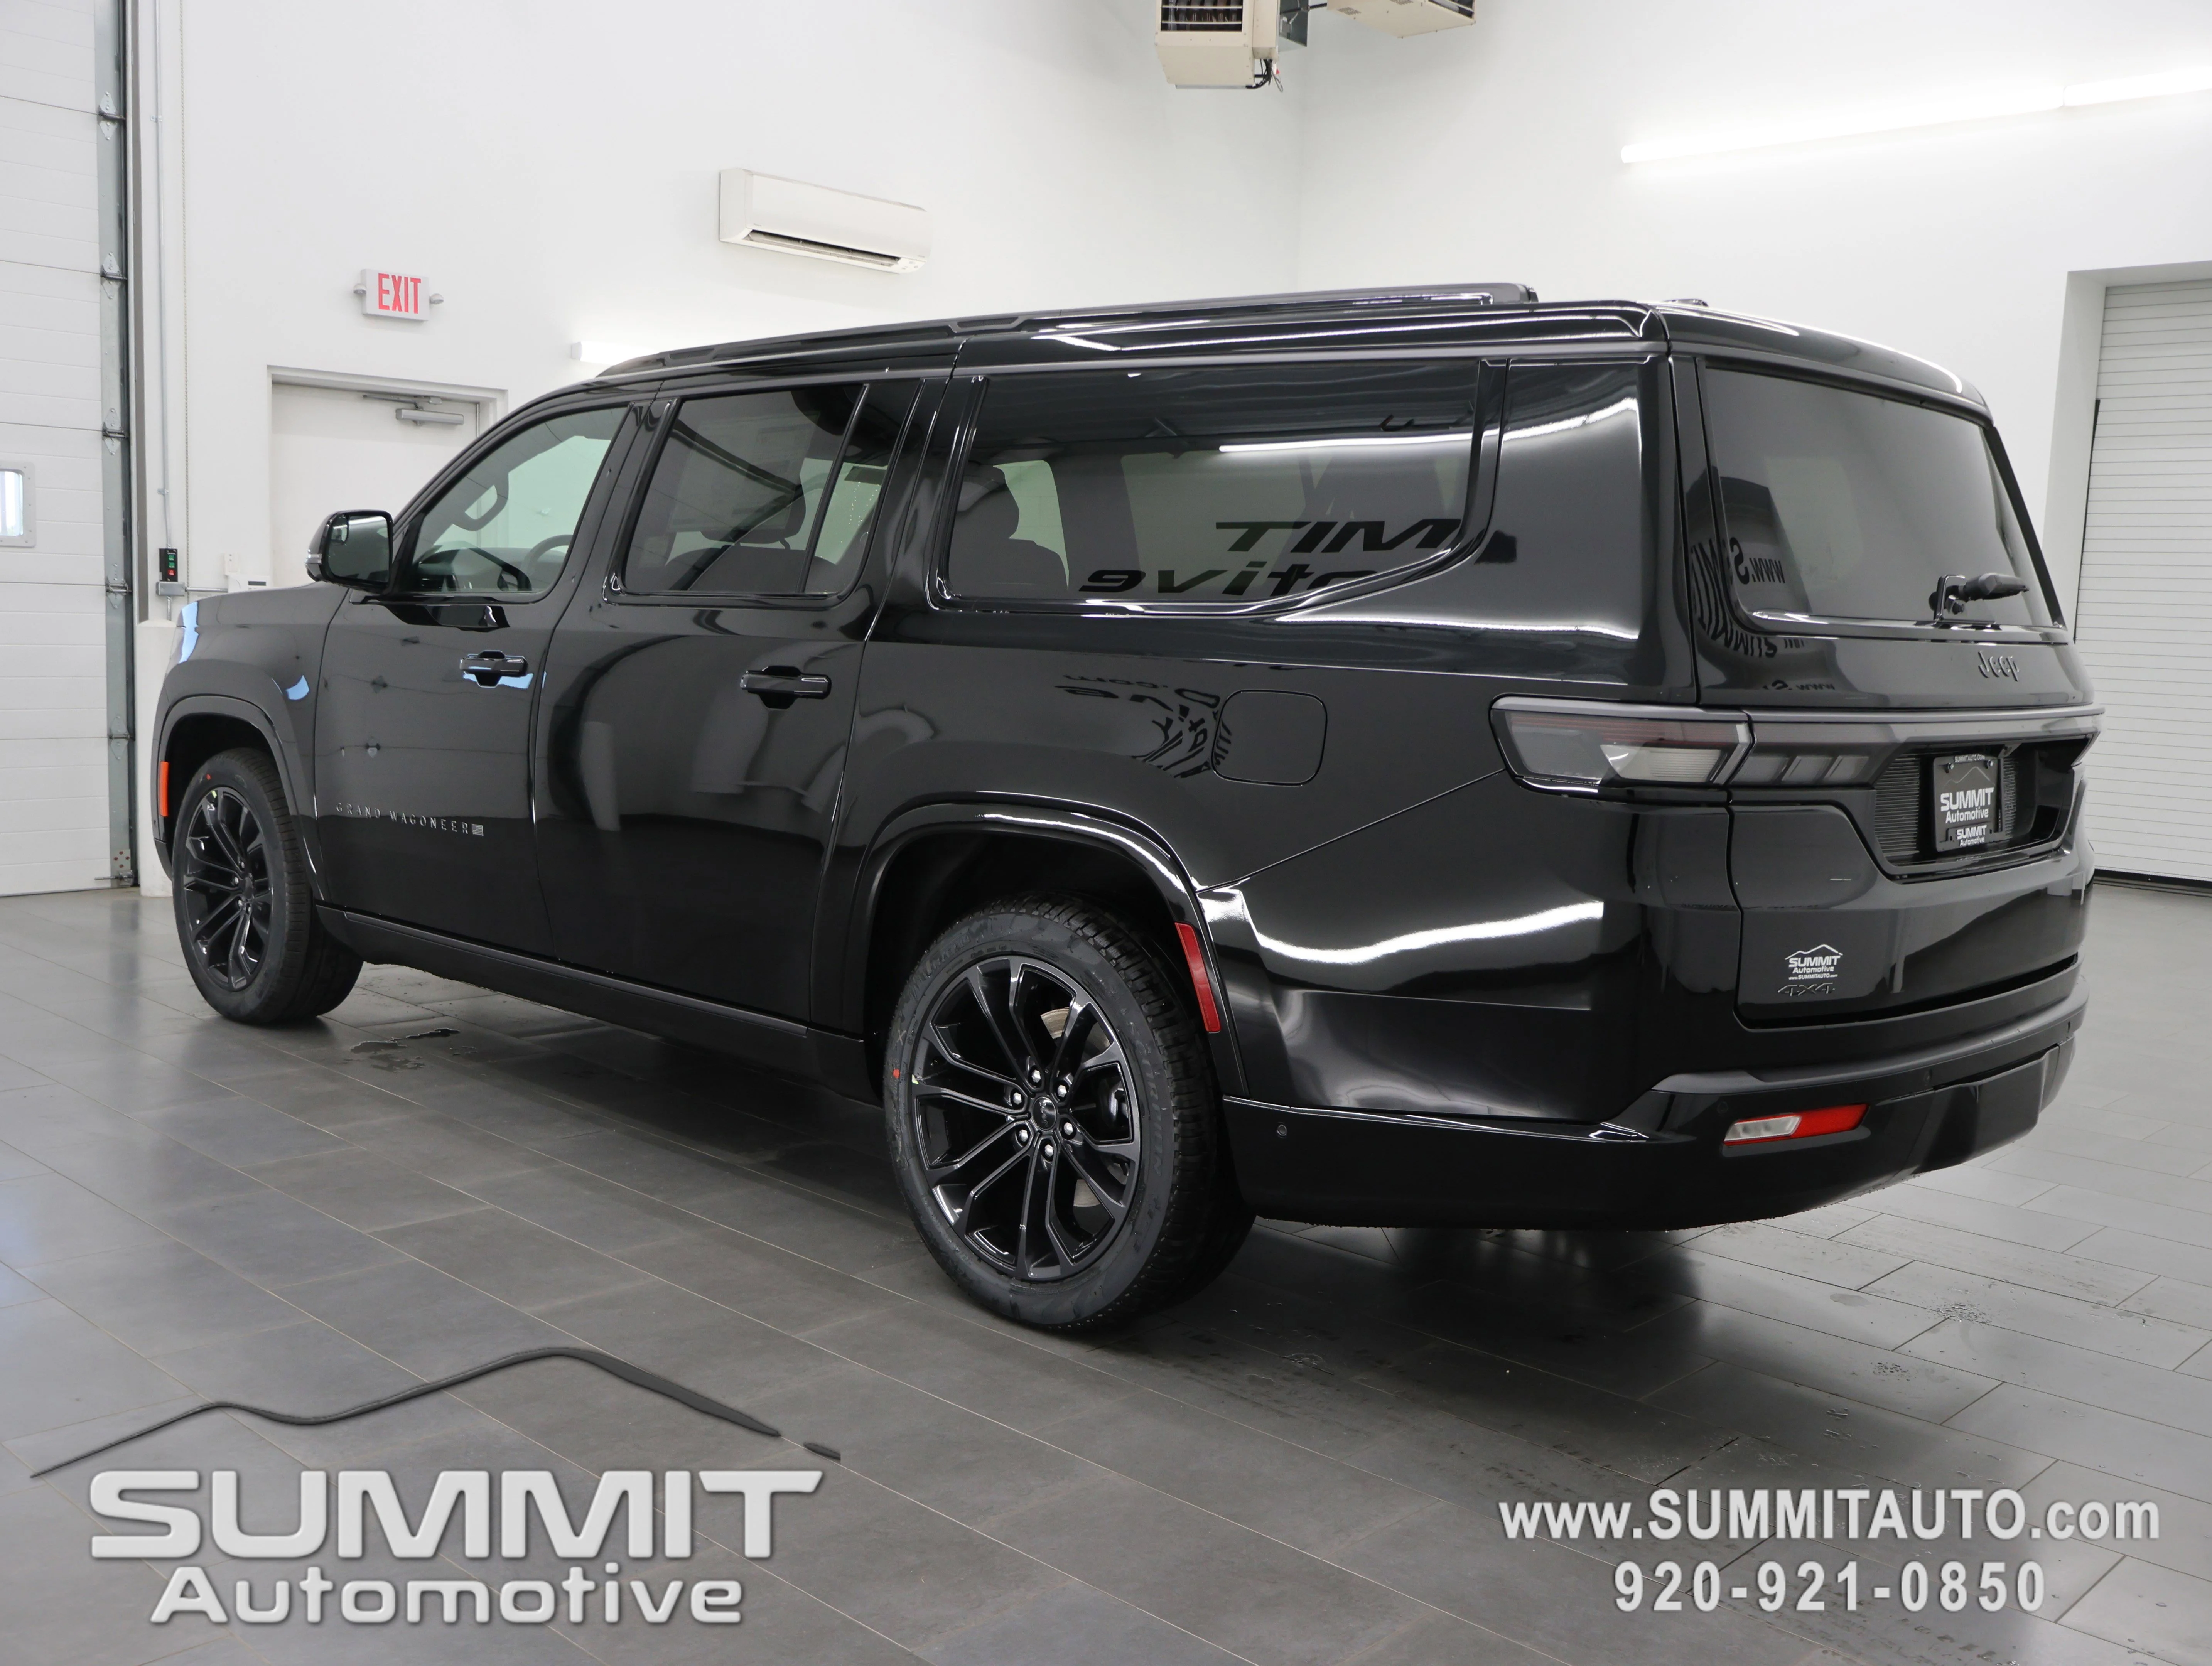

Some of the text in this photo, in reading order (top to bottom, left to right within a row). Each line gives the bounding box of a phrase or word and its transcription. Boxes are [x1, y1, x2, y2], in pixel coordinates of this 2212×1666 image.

[378, 273, 421, 314] EXIT
[1978, 650, 2020, 682] Jeep
[1940, 787, 1994, 811] SUMMIT
[336, 802, 469, 834] GRAND WAGONEER
[1945, 806, 1989, 823] Automotive
[1956, 825, 1987, 840] SUMMIT
[1960, 836, 1985, 846] Automotive
[1788, 955, 1841, 968] SUMMIT
[1792, 965, 1834, 974] Automotive
